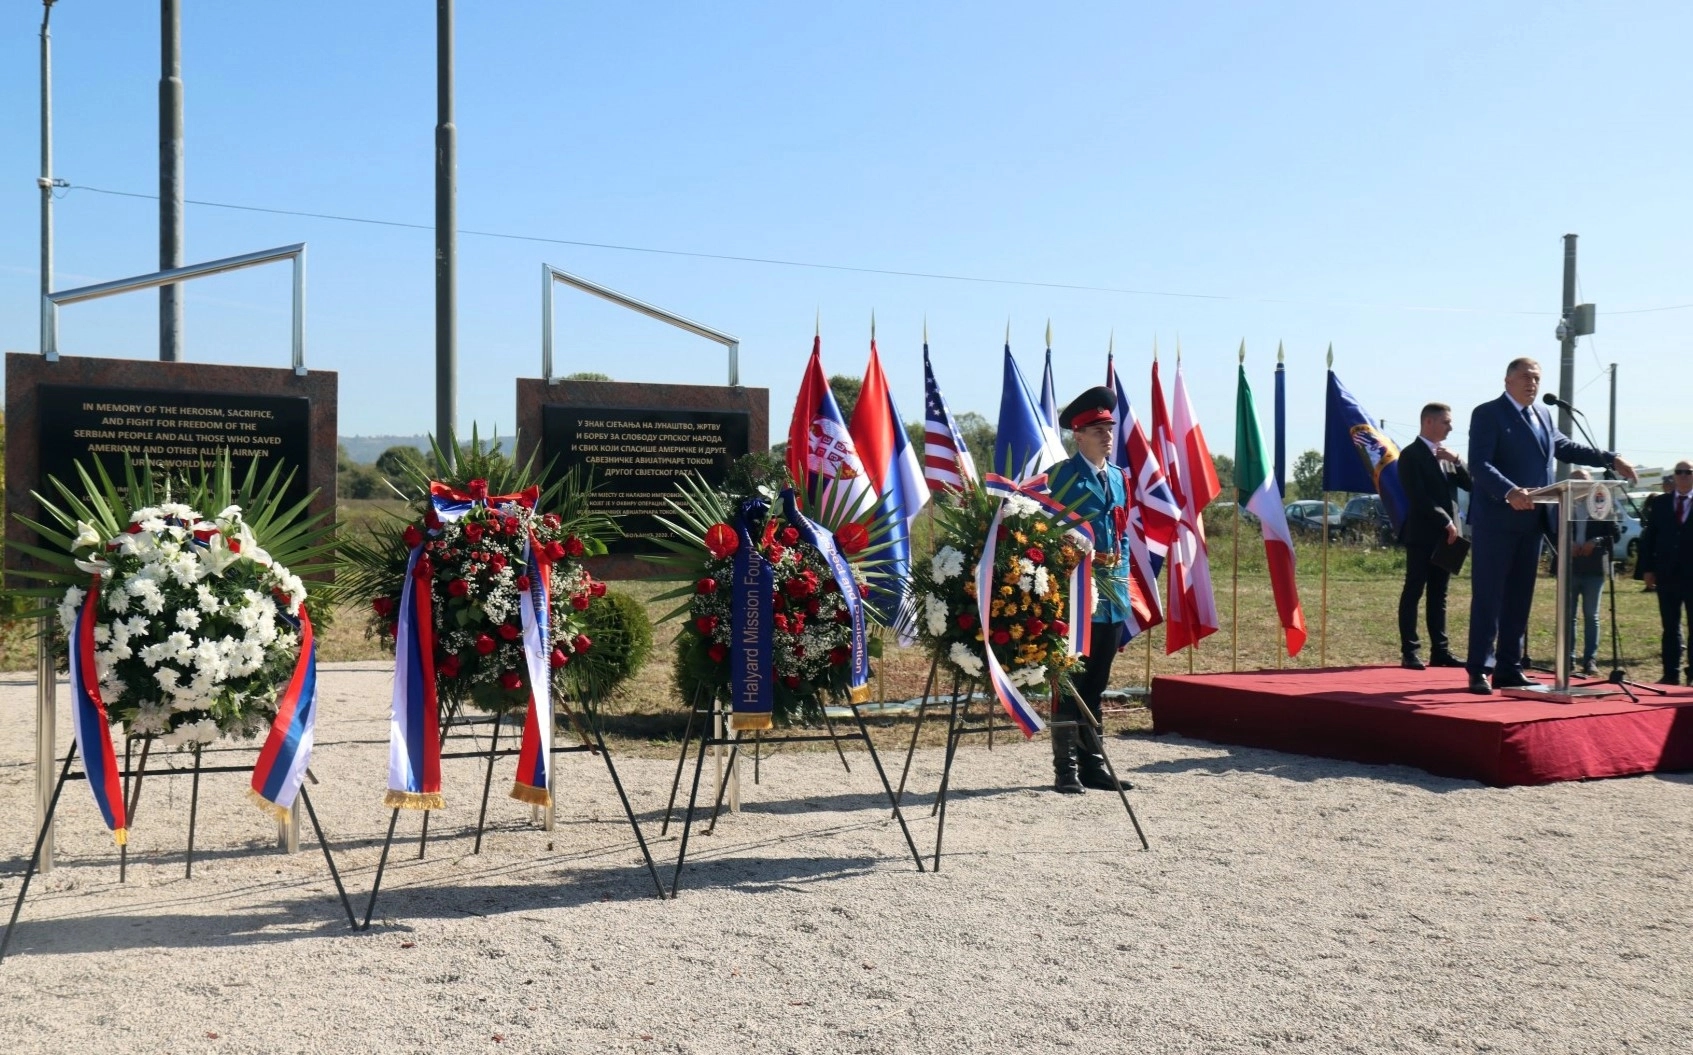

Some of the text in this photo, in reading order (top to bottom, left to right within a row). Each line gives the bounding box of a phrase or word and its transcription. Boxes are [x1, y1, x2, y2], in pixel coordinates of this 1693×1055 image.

[83, 402, 274, 420] IN MEMORY OF THE HEROISM, SACRIFICE,
[102, 417, 256, 430] AND FIGHT FOR FREEDOM OF THE
[654, 422, 695, 430] ЈУНАШТВО,
[74, 430, 282, 444] SERBIAN PEOPLE AND ALL THOSE WHO SAVED
[622, 434, 657, 442] СЛОБОДУ
[88, 444, 140, 453] AMERICAN
[142, 446, 164, 454] AND
[166, 446, 198, 455] OTHER
[232, 448, 269, 457] AIRMEN
[604, 468, 633, 476] ДРУГОГ
[842, 578, 858, 600] and
[744, 608, 759, 646] Mission
[743, 648, 762, 702] Halyard
